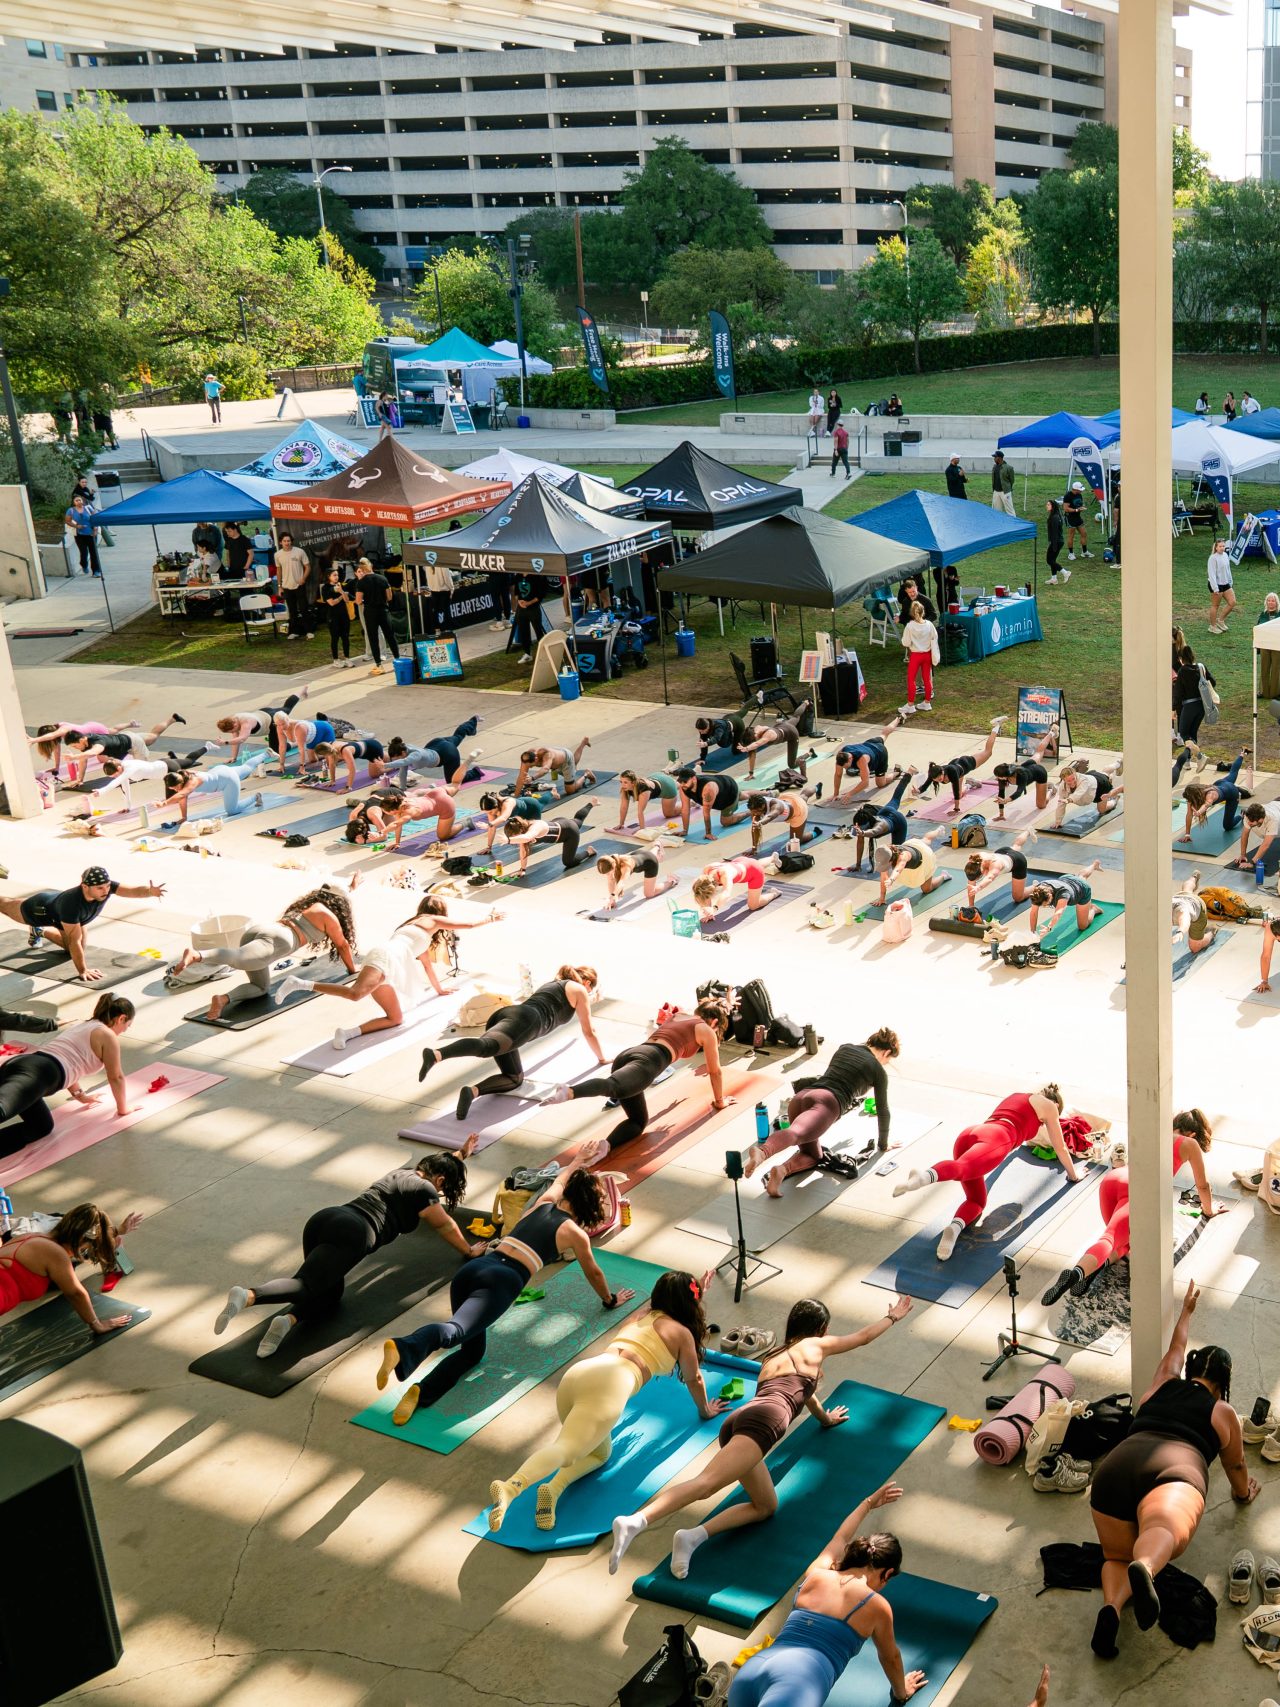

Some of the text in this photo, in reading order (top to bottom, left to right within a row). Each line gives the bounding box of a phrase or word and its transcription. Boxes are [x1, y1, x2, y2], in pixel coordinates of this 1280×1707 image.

[715, 332, 723, 370] Welcome
[278, 442, 300, 457] PLAYA
[302, 442, 321, 458] BOWLS
[1072, 446, 1092, 457] F45
[1202, 457, 1221, 471] F45
[507, 477, 533, 515] SWEAT
[624, 486, 689, 502] OPAL
[709, 481, 768, 502] OPAL
[273, 502, 305, 512] HEART&SOIL
[324, 505, 356, 516] HEART&SOIL
[299, 535, 333, 548] SUPPLEMENTS
[606, 537, 638, 563] ZILKER
[459, 552, 505, 571] ZILKER
[1018, 710, 1060, 724] STRENGTH
